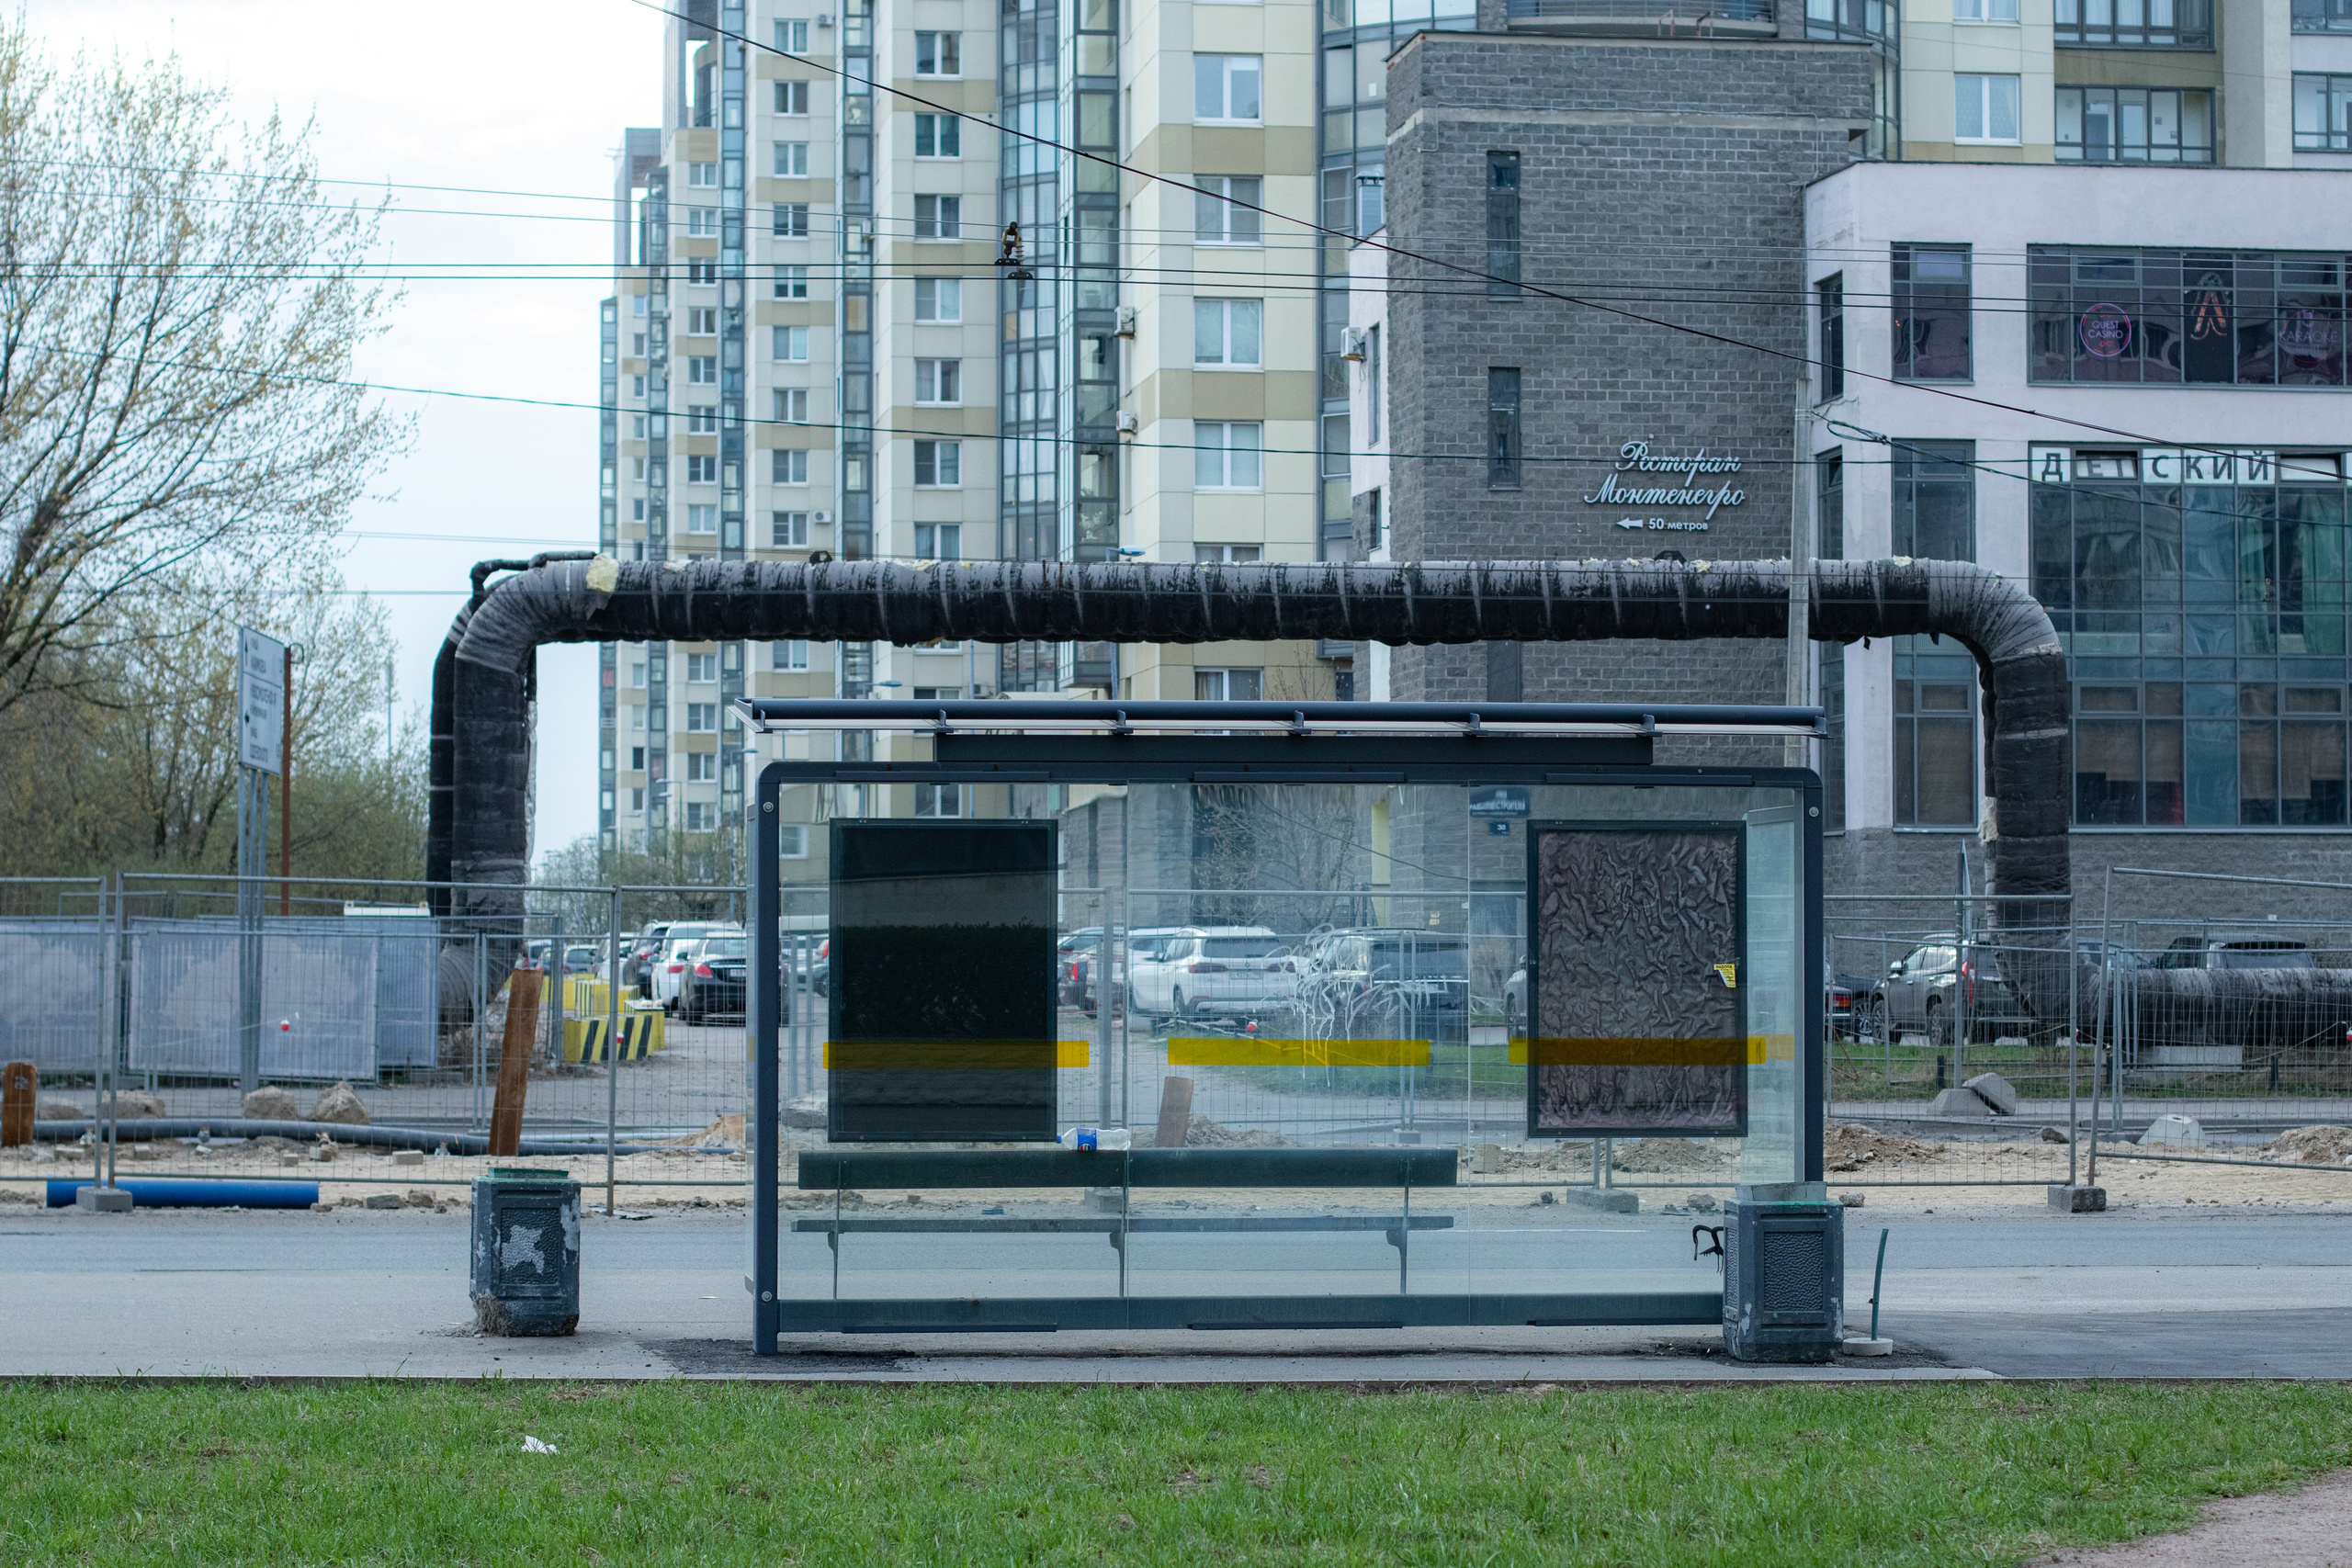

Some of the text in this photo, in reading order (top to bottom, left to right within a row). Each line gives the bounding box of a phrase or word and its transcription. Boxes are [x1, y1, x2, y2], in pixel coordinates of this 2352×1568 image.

[2092, 320, 2119, 329] QUEST
[2087, 330, 2123, 339] CASINO
[2278, 331, 2337, 343] KARAOKE
[1614, 440, 1742, 487] Ресторан
[2041, 449, 2268, 482] ДЕТСКИЙ
[1583, 473, 1746, 521] Монтенегро
[1648, 518, 1709, 532] 50 метров
